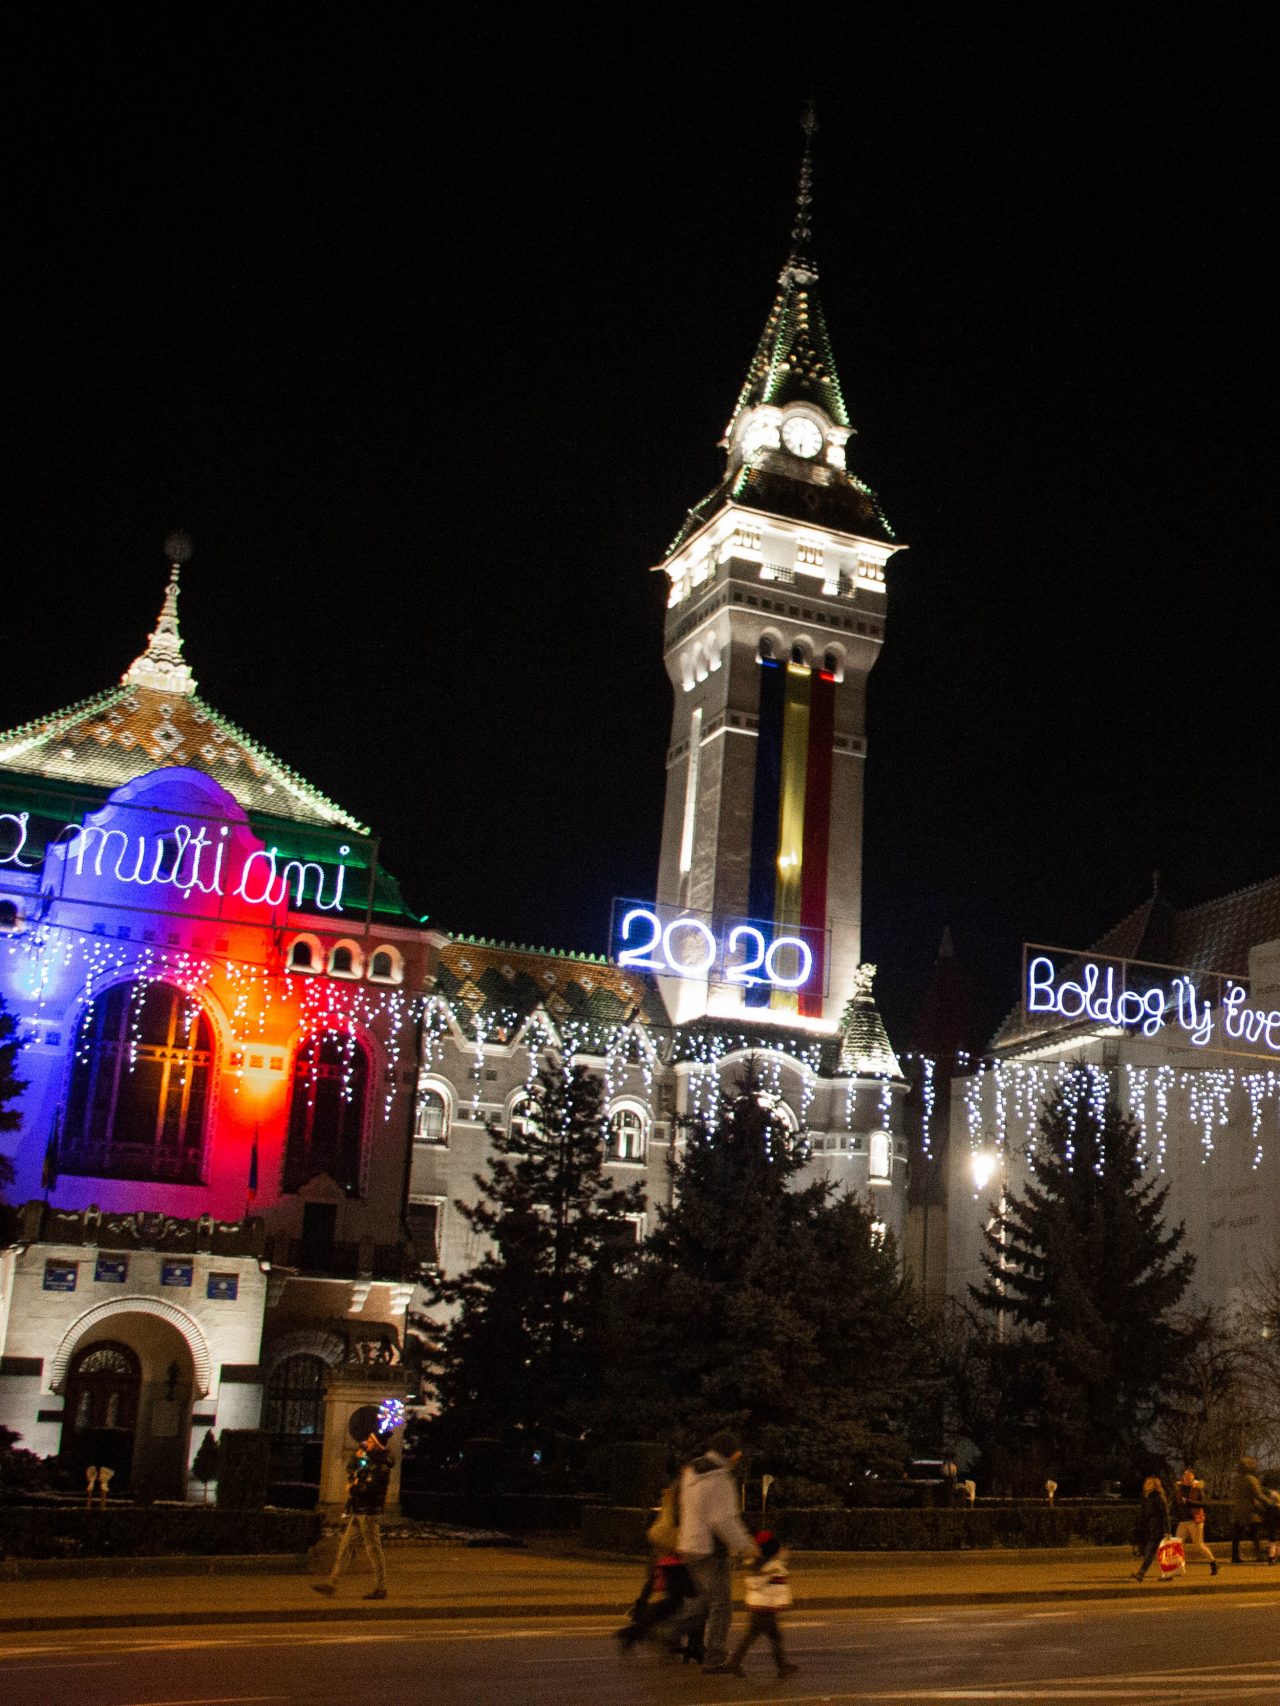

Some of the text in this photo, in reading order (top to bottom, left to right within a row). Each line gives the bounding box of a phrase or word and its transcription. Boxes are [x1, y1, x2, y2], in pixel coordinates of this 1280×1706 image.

[233, 846, 350, 911] ani
[618, 908, 813, 988] 2020
[1029, 957, 1166, 1037] Boldog
